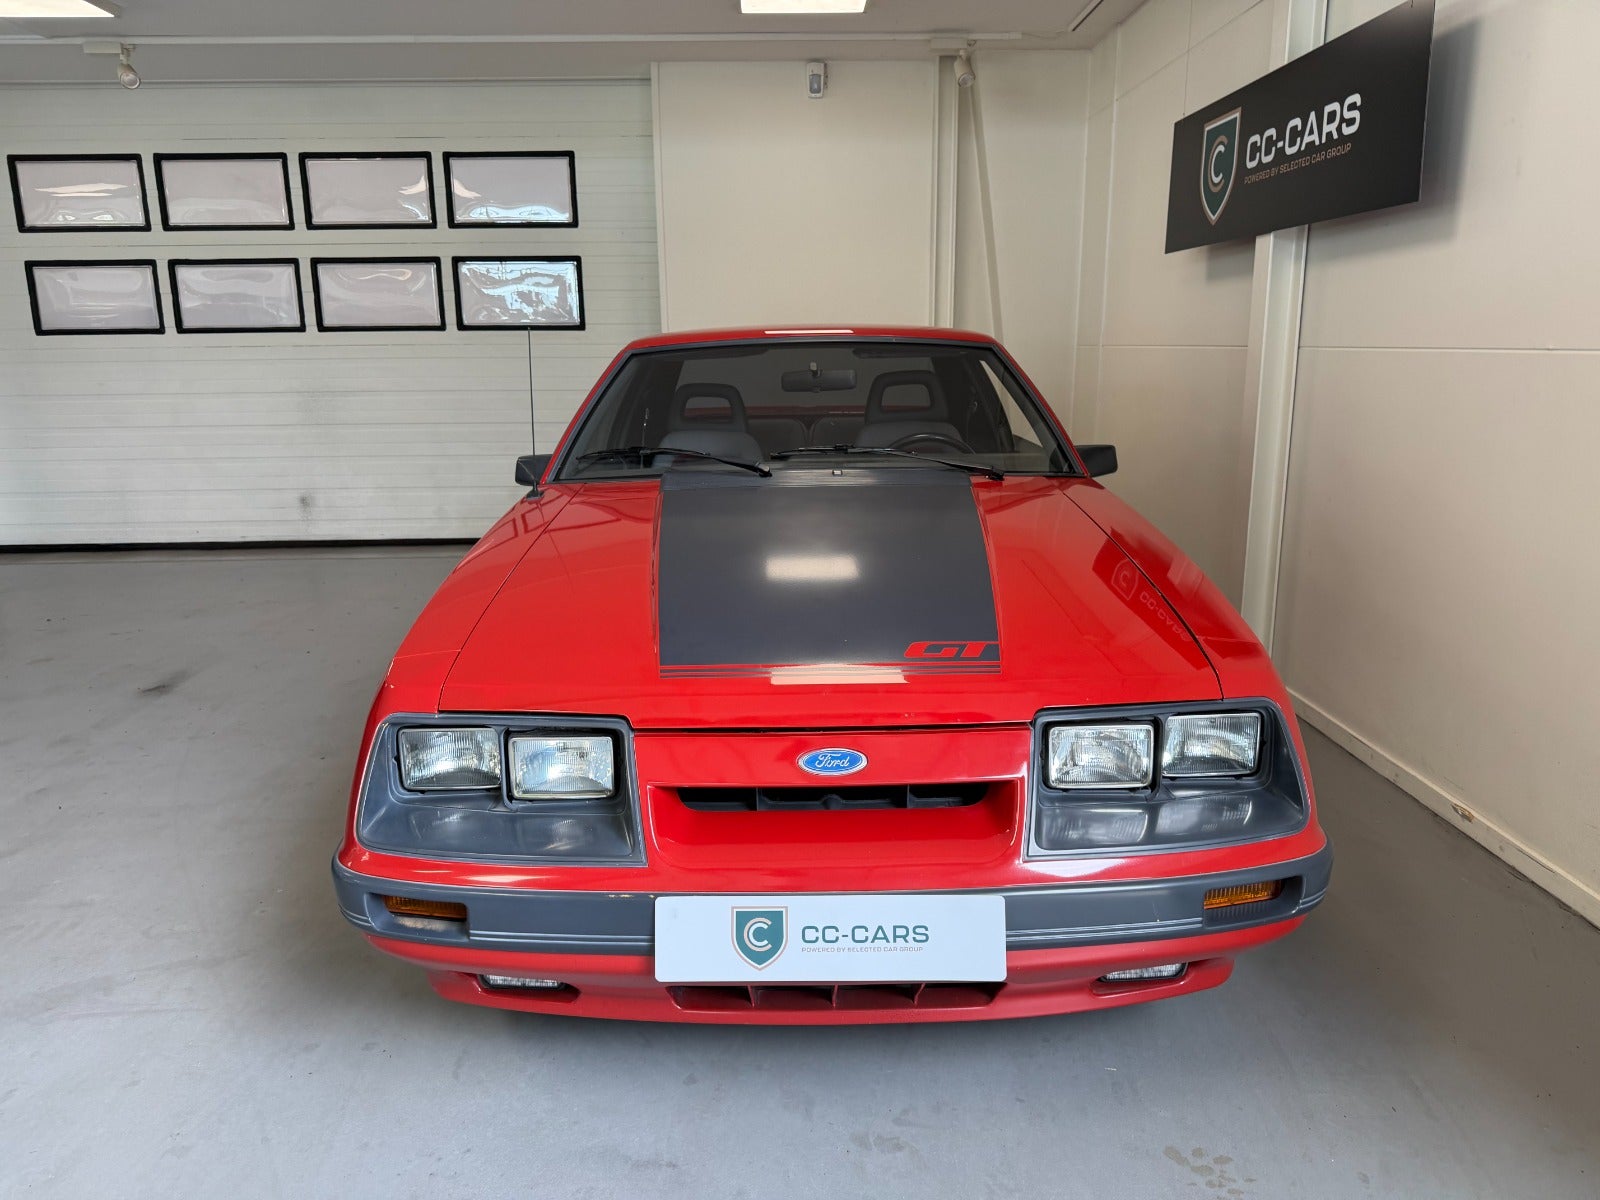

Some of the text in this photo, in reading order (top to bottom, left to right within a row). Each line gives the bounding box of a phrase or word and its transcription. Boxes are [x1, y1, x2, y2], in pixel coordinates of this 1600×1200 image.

[1245, 93, 1362, 169] CC-CARS
[1244, 142, 1352, 185] POWERED BY SELECTED CAR GROUP
[903, 641, 998, 659] GT
[815, 753, 850, 768] Ford
[801, 925, 930, 944] CC-CARS
